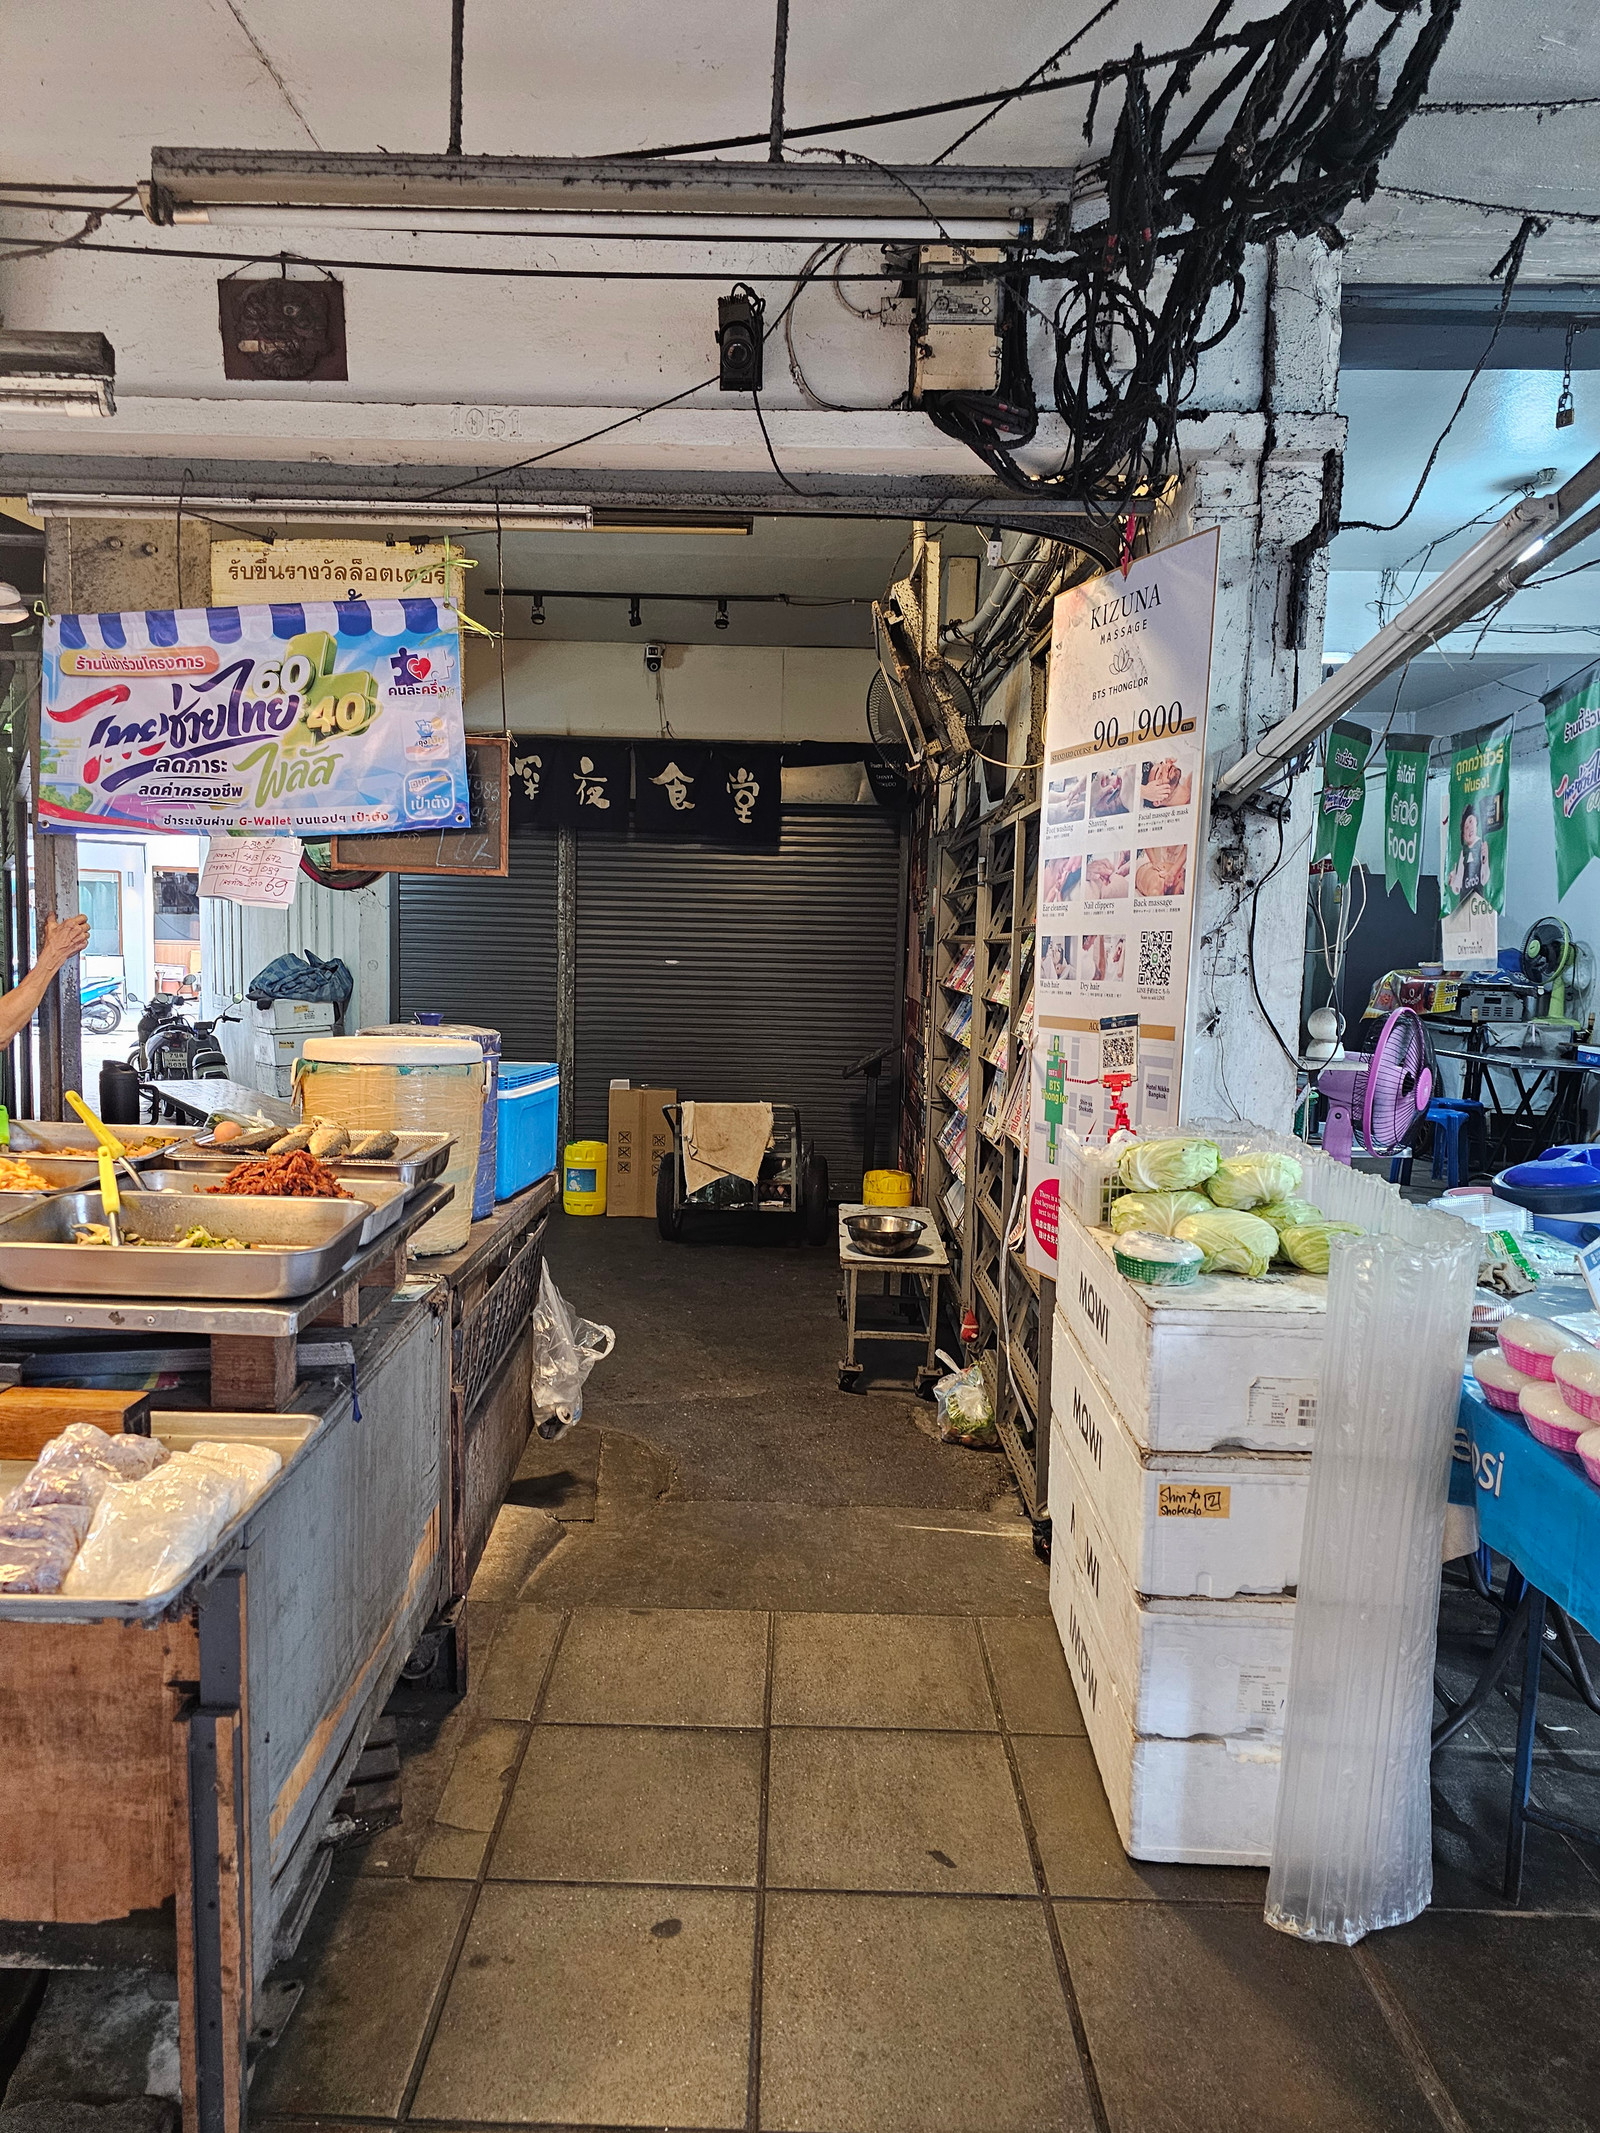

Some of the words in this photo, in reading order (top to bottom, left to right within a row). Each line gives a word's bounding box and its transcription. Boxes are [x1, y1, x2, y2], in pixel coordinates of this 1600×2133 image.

[1090, 583, 1162, 631] KIZUNA
[1099, 618, 1148, 645] MASSAGE
[76, 651, 205, 672] ร้านนี้เข้าร่วมโครงการ
[253, 655, 315, 698] 60
[388, 679, 447, 696] คนละครึ่ง
[1092, 689, 1106, 701] BTS
[1109, 677, 1149, 696] THONGLOR
[46, 659, 300, 785] ไทยช่วยไทย
[306, 693, 366, 736] 40
[1094, 717, 1119, 751] 90
[1138, 701, 1183, 741] 900
[155, 759, 227, 774] ลดภาระ
[138, 782, 243, 798] ลดค่าครองชีพ
[410, 795, 450, 811] เป๋าตัง
[1390, 792, 1419, 827] Grab
[163, 814, 234, 827] ชำระเงินผ่าน
[239, 816, 291, 827] G-Wallet
[296, 815, 346, 826] บนแอปฯ
[1387, 827, 1418, 864] Food
[265, 877, 289, 897] 69
[1048, 1080, 1061, 1092] BTS
[1148, 1091, 1167, 1100] Bangkok
